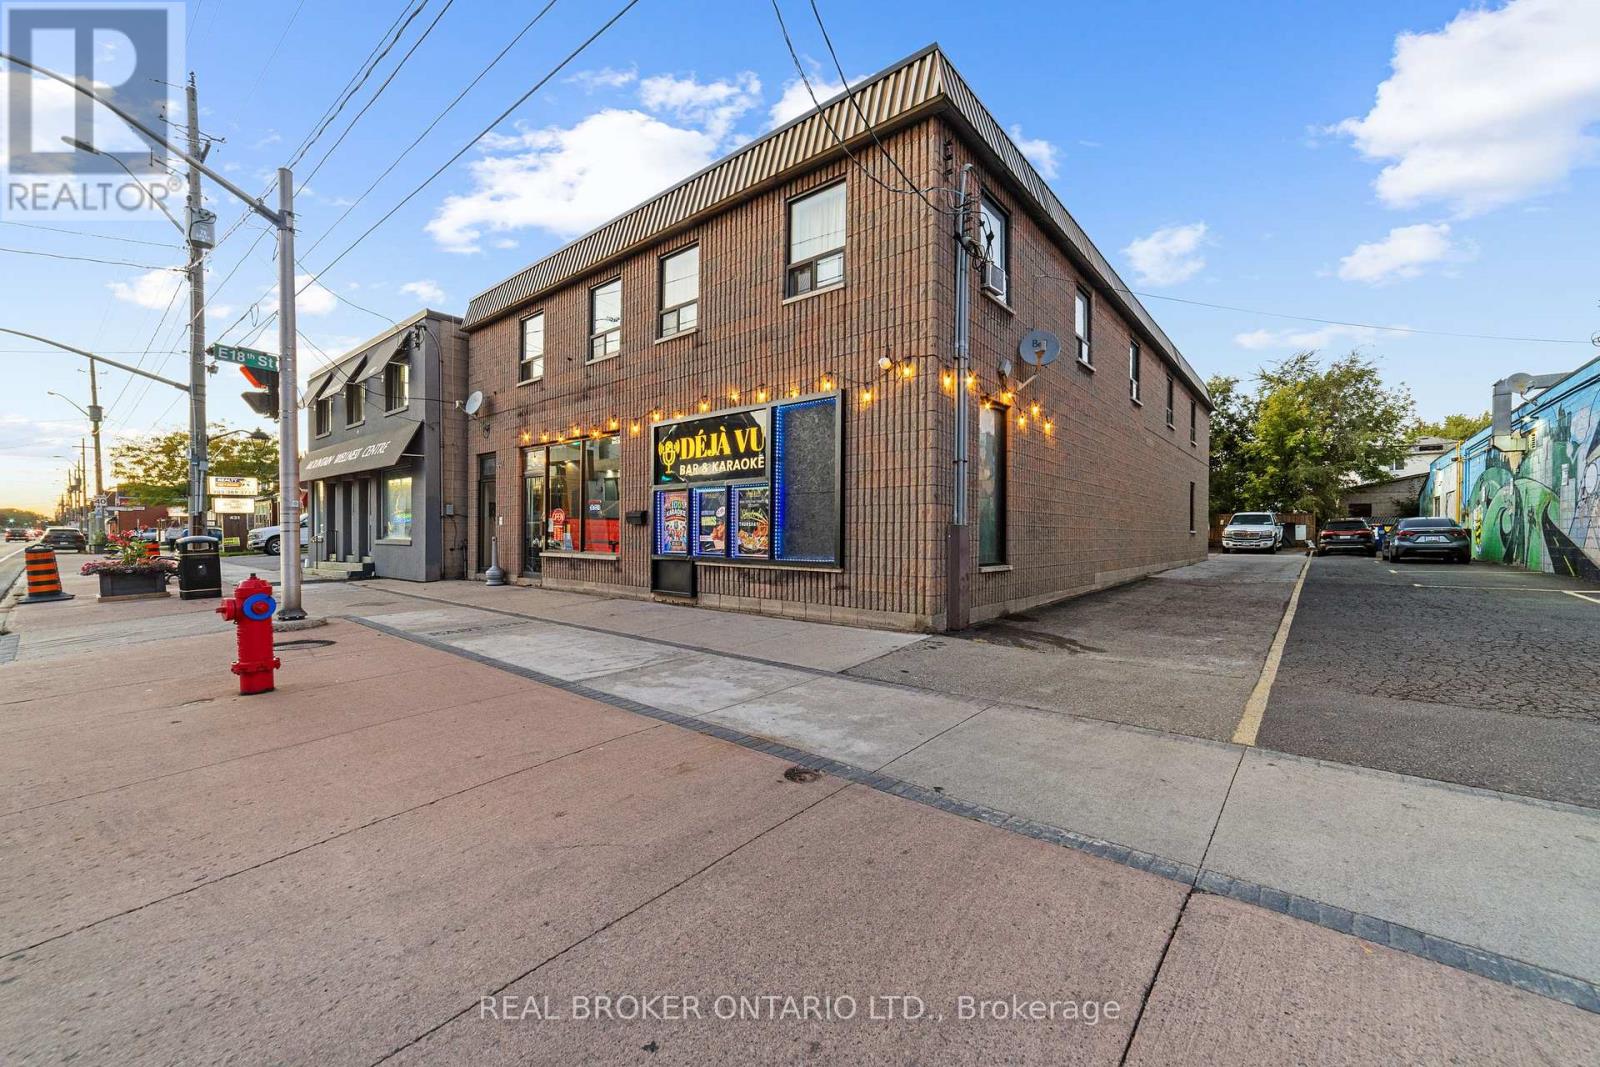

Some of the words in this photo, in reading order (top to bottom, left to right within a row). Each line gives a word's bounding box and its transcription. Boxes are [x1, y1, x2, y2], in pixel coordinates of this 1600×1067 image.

[257, 355, 274, 369] St
[362, 441, 391, 457] CENTRE
[680, 426, 732, 460] DÉJÀ
[734, 427, 766, 454] VU
[680, 463, 699, 476] BAR
[701, 462, 710, 473] &
